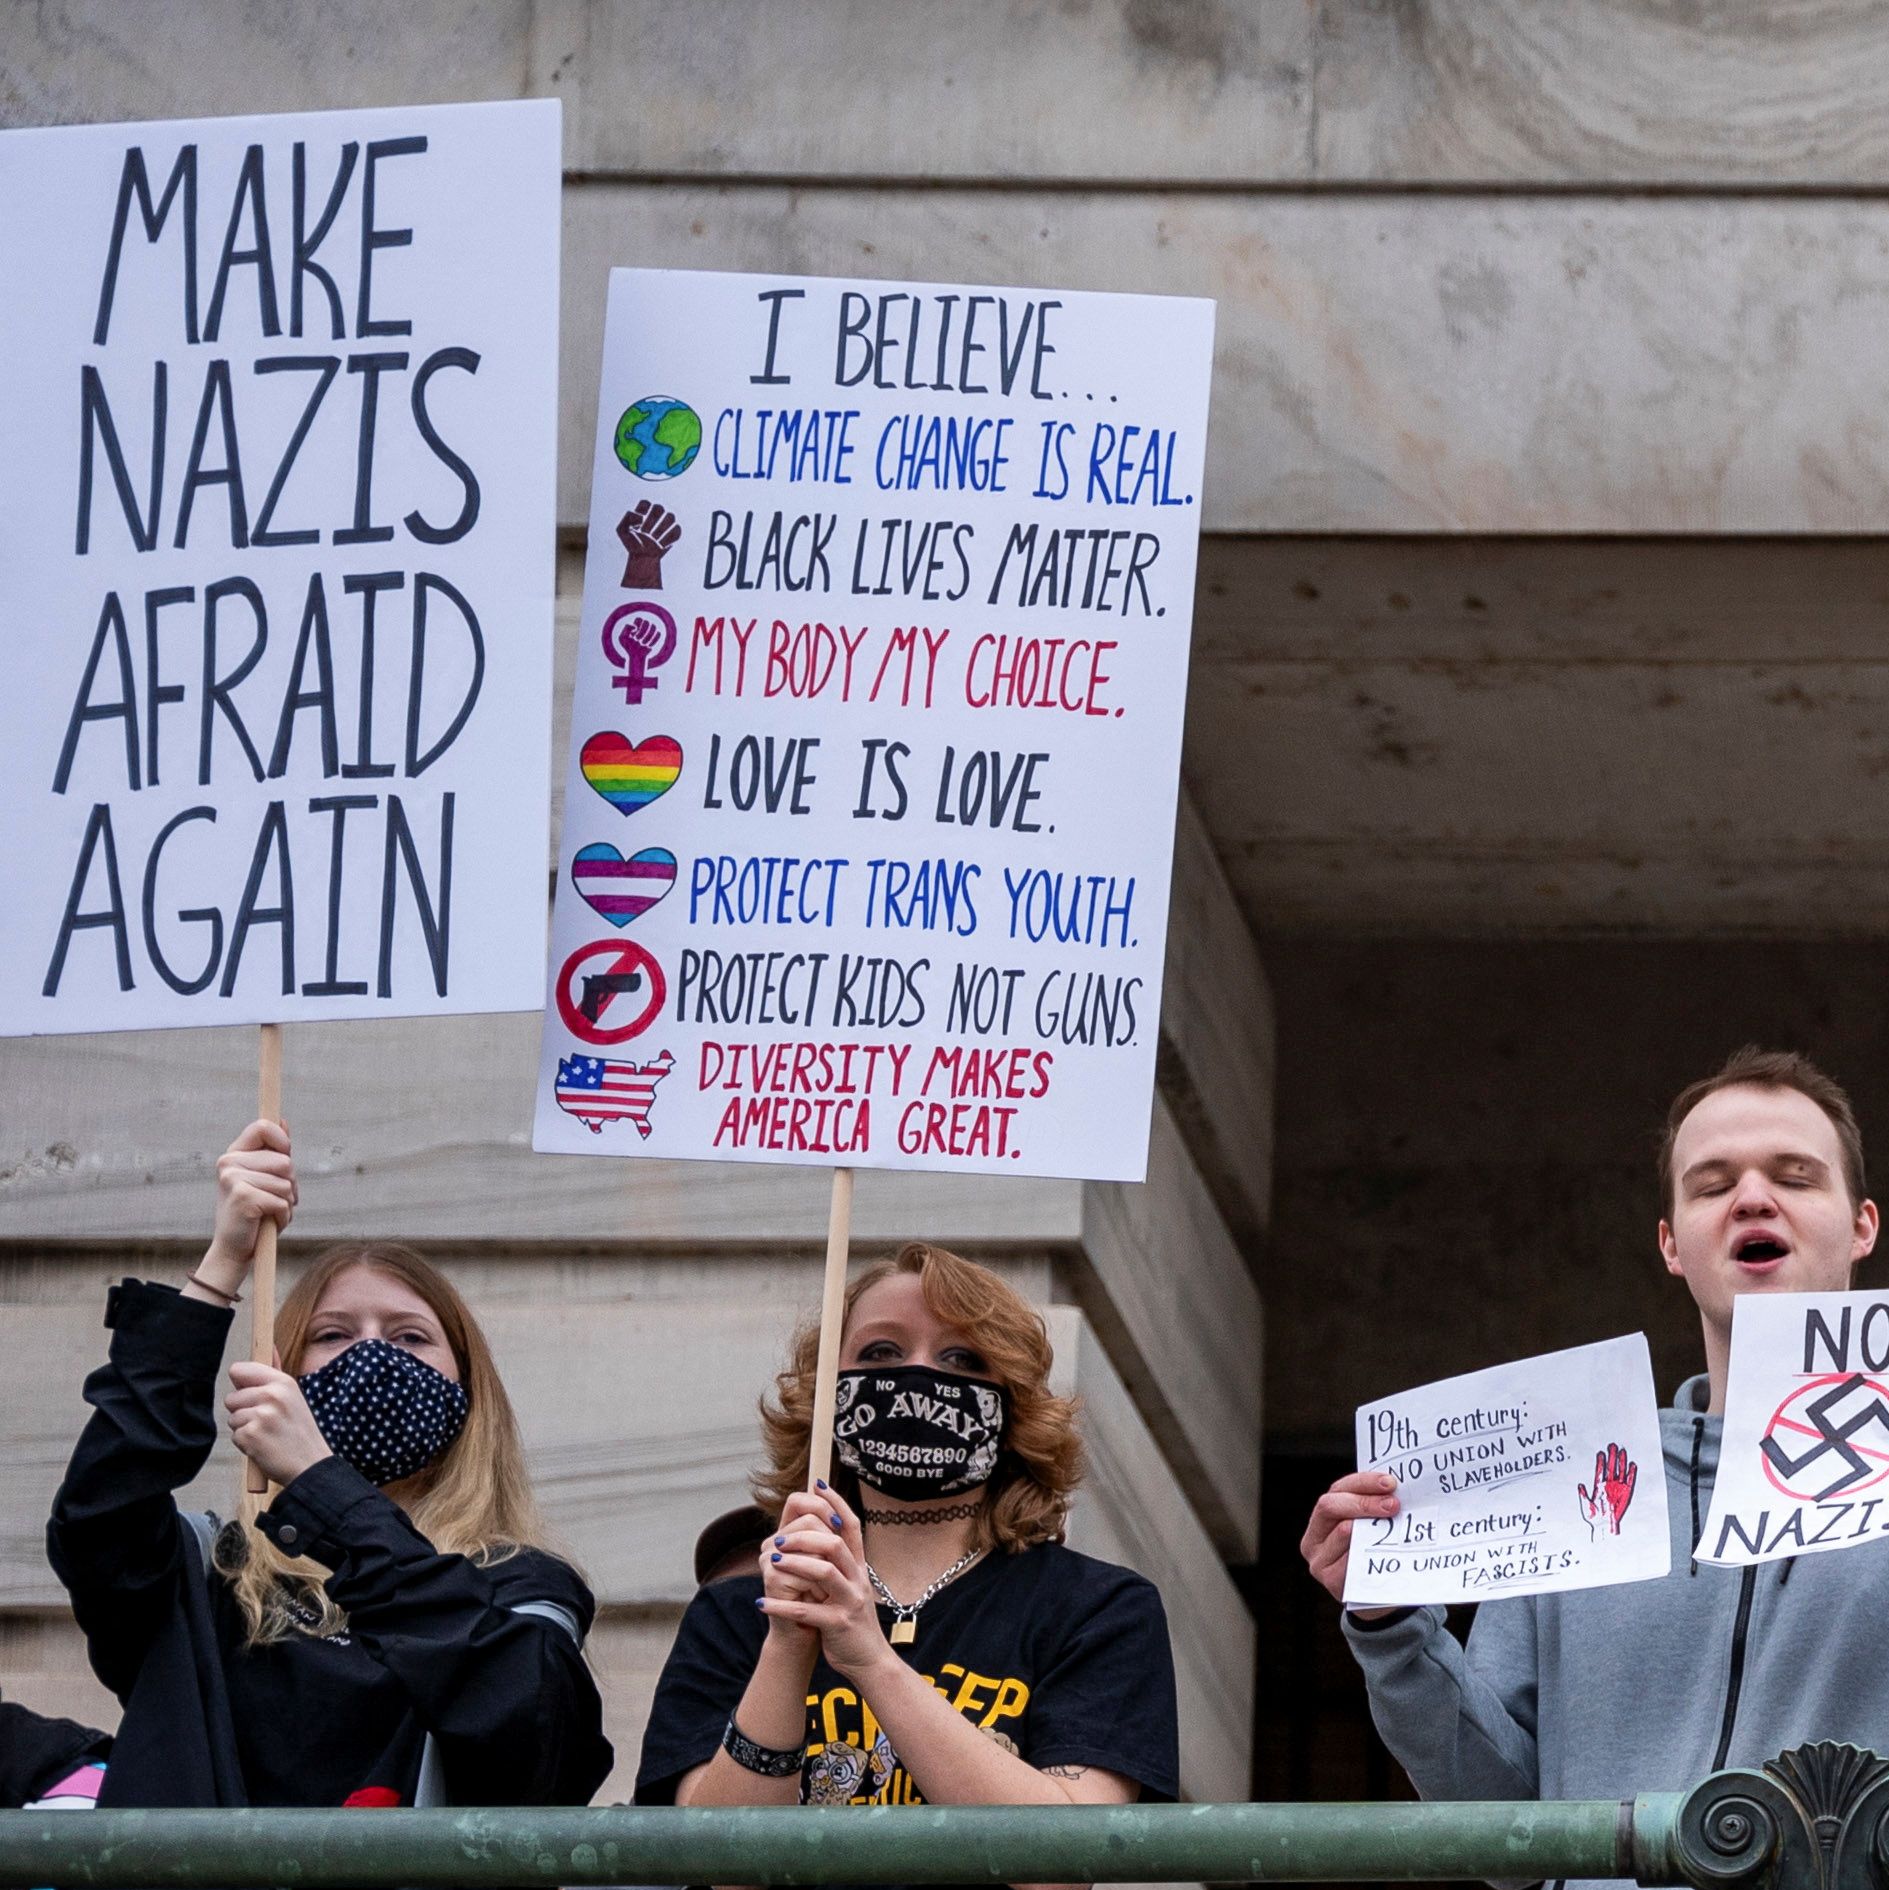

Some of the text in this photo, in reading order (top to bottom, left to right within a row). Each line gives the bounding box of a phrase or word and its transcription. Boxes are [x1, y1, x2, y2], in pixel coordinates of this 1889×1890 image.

[94, 136, 427, 344] MAKE
[749, 288, 805, 384] I
[76, 346, 480, 555] NAZIS
[713, 408, 1193, 506] CLIMATE CHANGE IS REAL.
[703, 510, 1166, 618] BLACK LIVES MATTER.
[52, 571, 484, 794] AFRAID
[685, 616, 1125, 718] MY BODY MY CHOICE.
[703, 734, 1055, 834] LOVE IS LOVE.
[42, 791, 455, 998] AGAIN
[689, 856, 1139, 948] PROTECT TRANS YOUTH.
[676, 949, 1144, 1048] PROTECT KIDS NOT GUNS.
[699, 1041, 1053, 1099] DIVERSITY MAKES
[713, 1097, 1021, 1159] AMERICA GREAT.
[836, 1391, 989, 1442] GO AWAY
[876, 1380, 961, 1398] NO YES
[858, 1439, 967, 1464] 1234567890
[1368, 1401, 1528, 1463] 19th century:
[1388, 1421, 1567, 1483] NO UNION WITH
[876, 1462, 944, 1478] GOOD BYE
[1439, 1445, 1571, 1494] SLAVEHOLDERS.
[1371, 1505, 1542, 1546] 21st century:
[1367, 1541, 1538, 1575] NO UNION WITH
[1463, 1550, 1580, 1588] FASCISTS.
